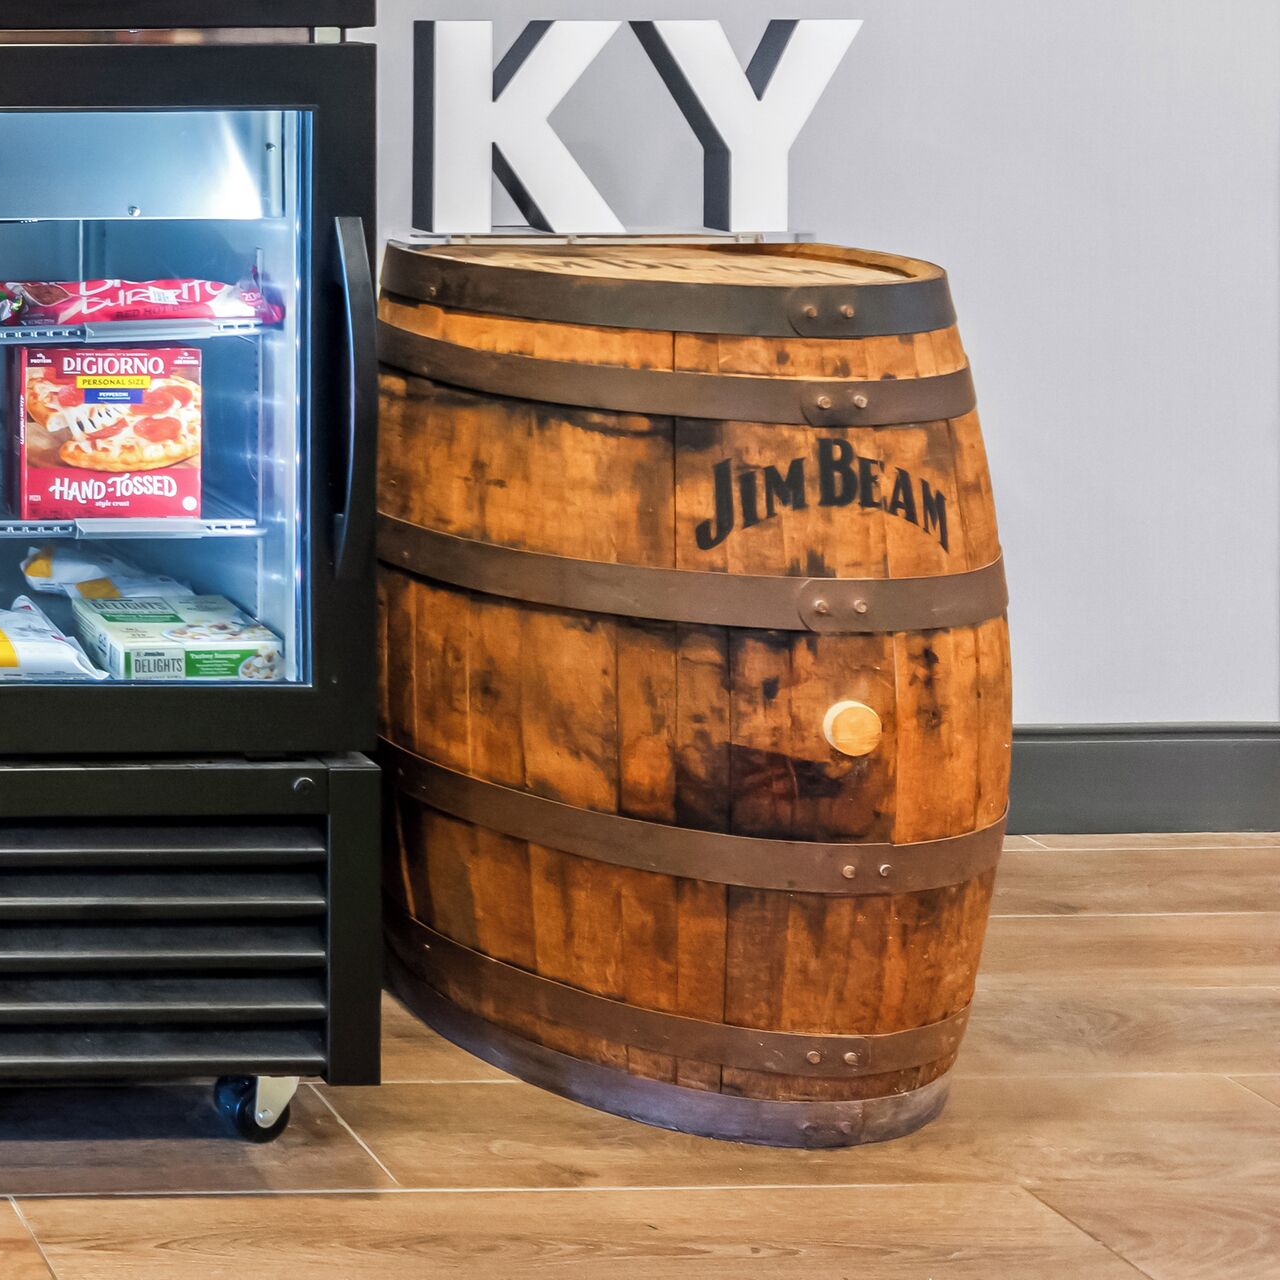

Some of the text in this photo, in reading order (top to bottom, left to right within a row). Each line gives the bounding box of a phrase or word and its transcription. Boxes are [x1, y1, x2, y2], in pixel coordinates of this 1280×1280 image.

[412, 19, 863, 233] KY
[116, 305, 167, 319] RED HOT
[49, 473, 178, 504] HAND-TOSSED
[695, 436, 951, 554] JIM BEAM
[94, 600, 167, 611] DELIGHTS
[134, 658, 183, 674] DELIGHTS
